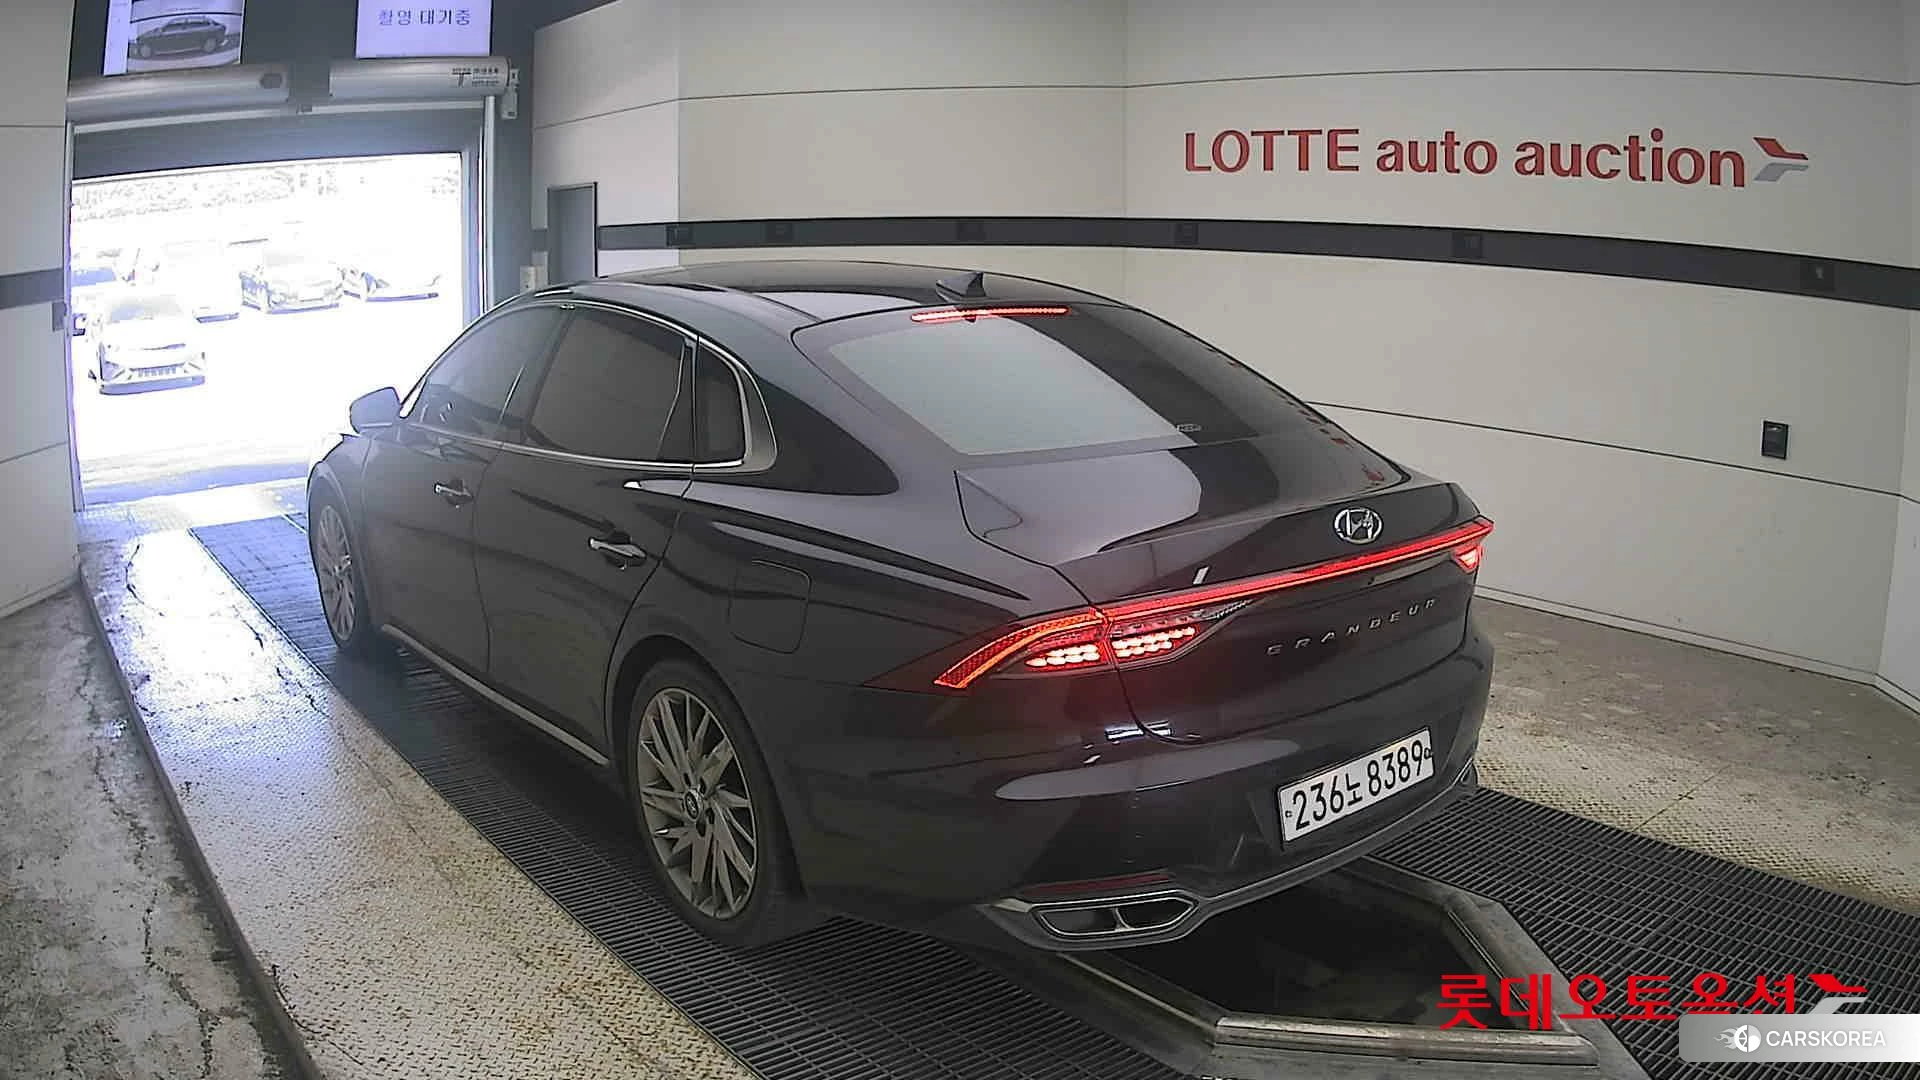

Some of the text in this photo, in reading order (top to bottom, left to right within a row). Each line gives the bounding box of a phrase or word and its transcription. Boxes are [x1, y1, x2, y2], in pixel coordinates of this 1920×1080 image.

[420, 9, 470, 26] 대기중
[1185, 128, 1745, 188] LOTTE auto auction
[1267, 599, 1435, 655] GRANDEUR
